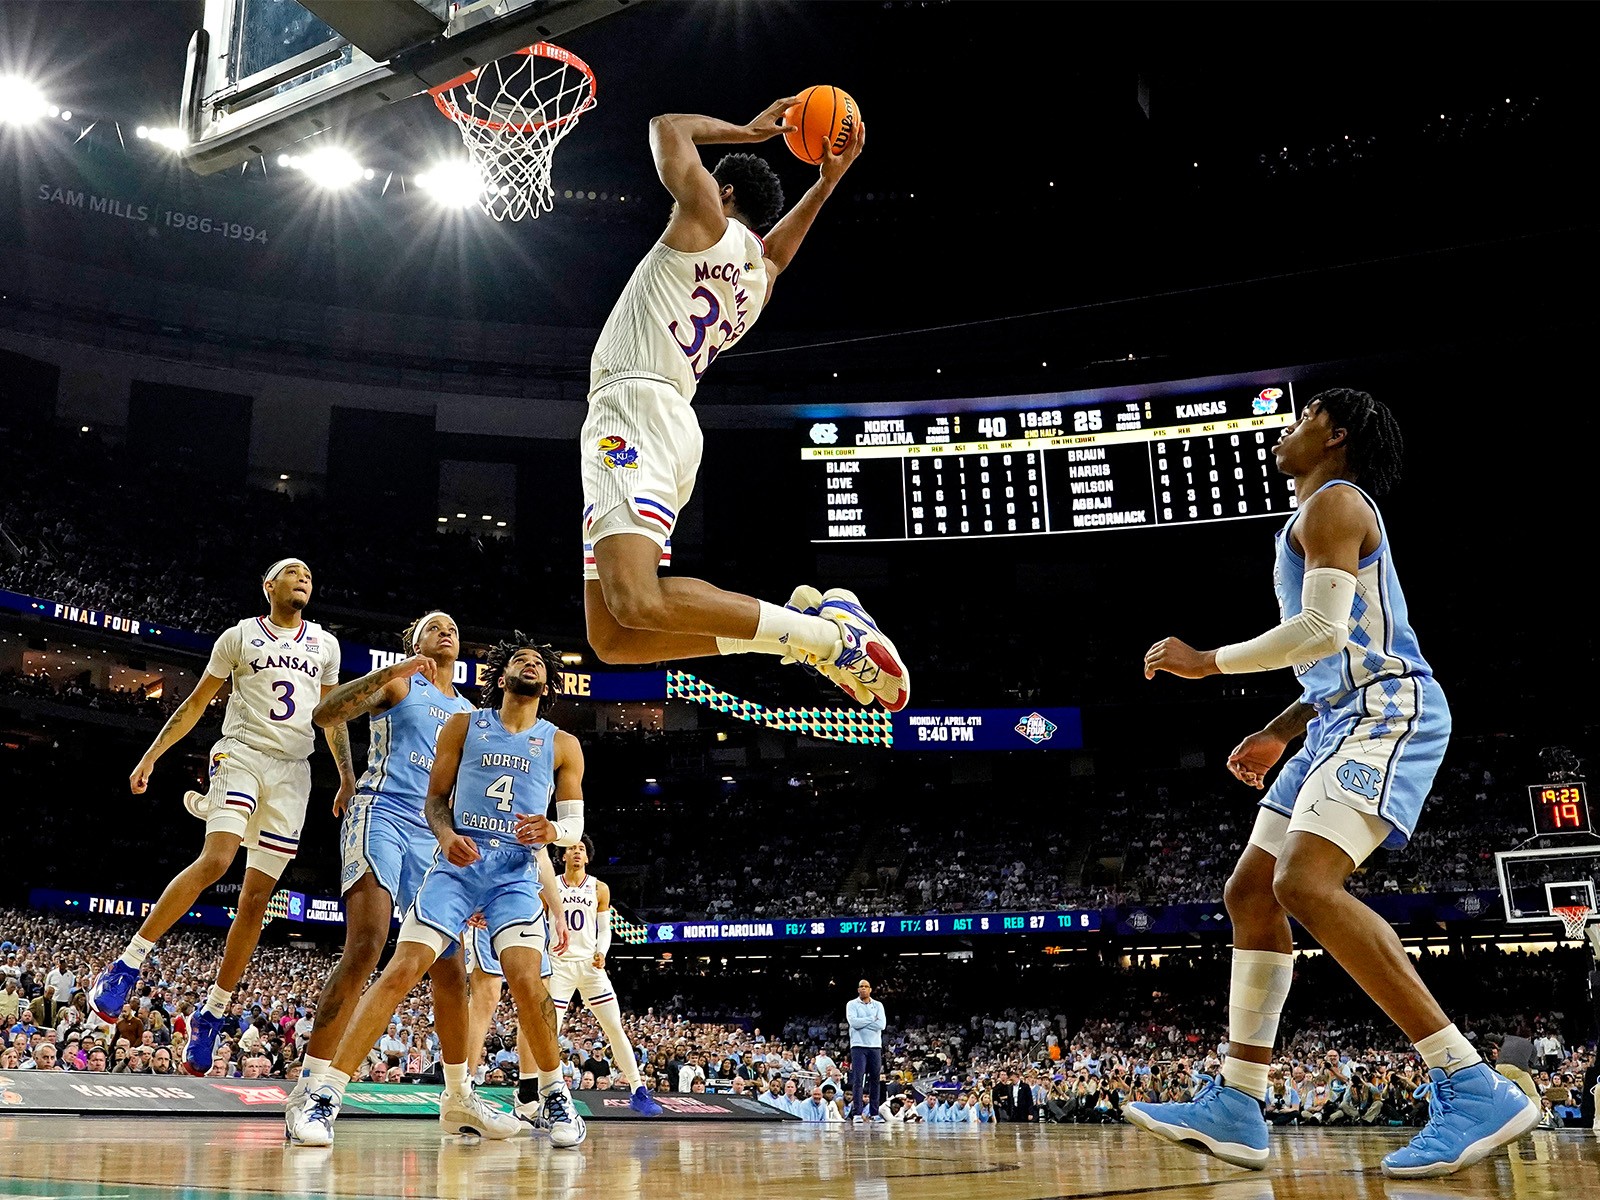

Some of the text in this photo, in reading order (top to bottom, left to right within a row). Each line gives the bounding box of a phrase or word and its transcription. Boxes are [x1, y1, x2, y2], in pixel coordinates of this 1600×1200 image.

[833, 96, 853, 149] Wilson
[38, 185, 268, 244] SAM MILLS 1986-1994
[1019, 410, 1062, 428] 19:23
[1176, 401, 1227, 418] KANSAS
[864, 420, 904, 433] NORTH
[978, 417, 1007, 438] 40
[1074, 410, 1102, 432] 25
[856, 432, 914, 445] CAROLINA
[1040, 428, 1057, 438] HALF
[1068, 432, 1264, 461] BRAUN 2 7 1 0 0
[827, 453, 1035, 473] BLACK 2 0 1 0 0 2
[1069, 449, 1266, 478] HARRIS 0 0 1 1 0
[827, 477, 852, 489] LOVE
[912, 475, 920, 486] 4
[937, 474, 942, 485] 1
[960, 473, 965, 484] 1
[981, 472, 989, 483] 0
[1006, 471, 1011, 482] 1
[1071, 465, 1267, 494] WILSON 4 1 0 0 1
[828, 485, 1037, 504] DAVIS 11 6 1 0 0 0
[1187, 489, 1195, 501] 3
[1212, 487, 1220, 498] 0
[1238, 484, 1244, 496] 1
[1263, 482, 1269, 493] 1
[1287, 479, 1295, 490] 0
[828, 509, 862, 521] BACOT
[935, 506, 947, 517] 10
[962, 505, 967, 516] 1
[985, 504, 990, 515] 1
[1007, 503, 1015, 514] 0
[1032, 501, 1037, 513] 1
[1073, 510, 1146, 527] MCCORMACK
[1189, 506, 1197, 518] 3
[1213, 503, 1222, 515] 0
[1238, 501, 1247, 513] 0
[1265, 498, 1271, 510] 1
[829, 525, 866, 537] MANEK
[938, 522, 946, 533] 4
[961, 521, 969, 533] 0
[984, 520, 992, 532] 0
[54, 603, 140, 634] FINAL FOUR
[249, 655, 319, 677] KANSAS
[271, 681, 295, 721] 3
[429, 706, 452, 722] NOR
[909, 716, 982, 726] MONDAY, APRIL 4TH
[918, 727, 974, 741] 9:40 PM
[481, 753, 531, 774] NORTH
[485, 774, 515, 812] 4
[1542, 788, 1580, 804] 19:23
[1554, 804, 1580, 828] 19
[89, 897, 134, 916] FINAL
[312, 899, 338, 910] NORTH
[562, 896, 593, 907] ANSAS
[306, 908, 344, 922] CAROLINA
[564, 909, 585, 931] 10
[684, 914, 1089, 938] NORTH CAROLINA FG% 36 3PT% 27 FT% 81 AST 5 REB 27 TO 6
[70, 1084, 195, 1100] KANSAS
